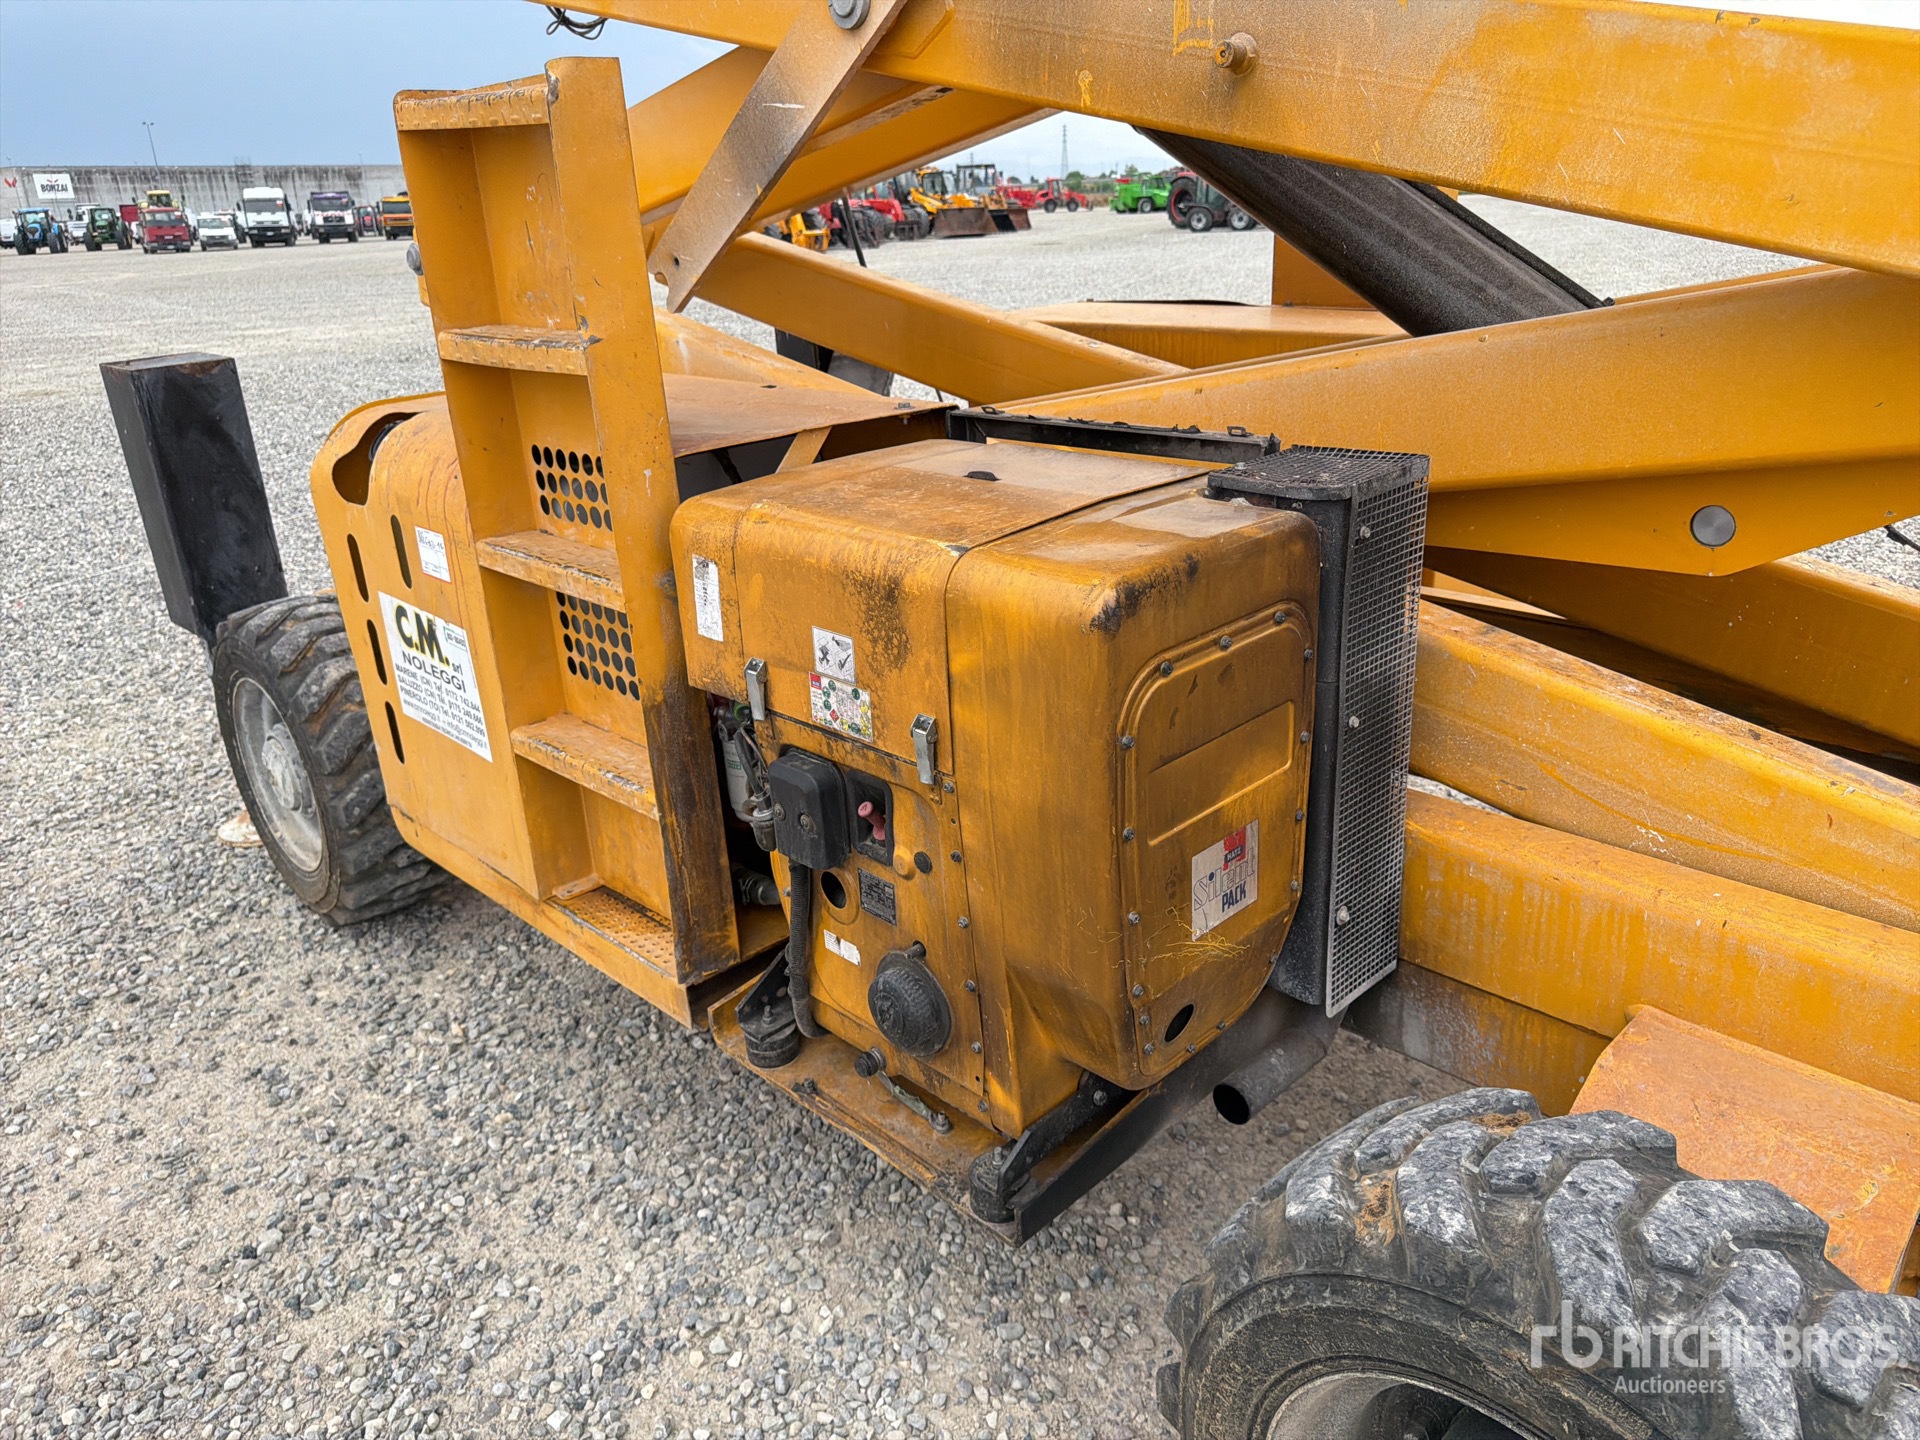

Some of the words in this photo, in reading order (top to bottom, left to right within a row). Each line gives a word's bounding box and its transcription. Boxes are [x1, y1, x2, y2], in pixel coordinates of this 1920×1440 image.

[395, 605, 450, 667] C.M.
[452, 663, 463, 676] srl
[402, 650, 466, 693] NOLEGGI
[1193, 847, 1256, 911] Silent
[1221, 880, 1247, 914] PACK
